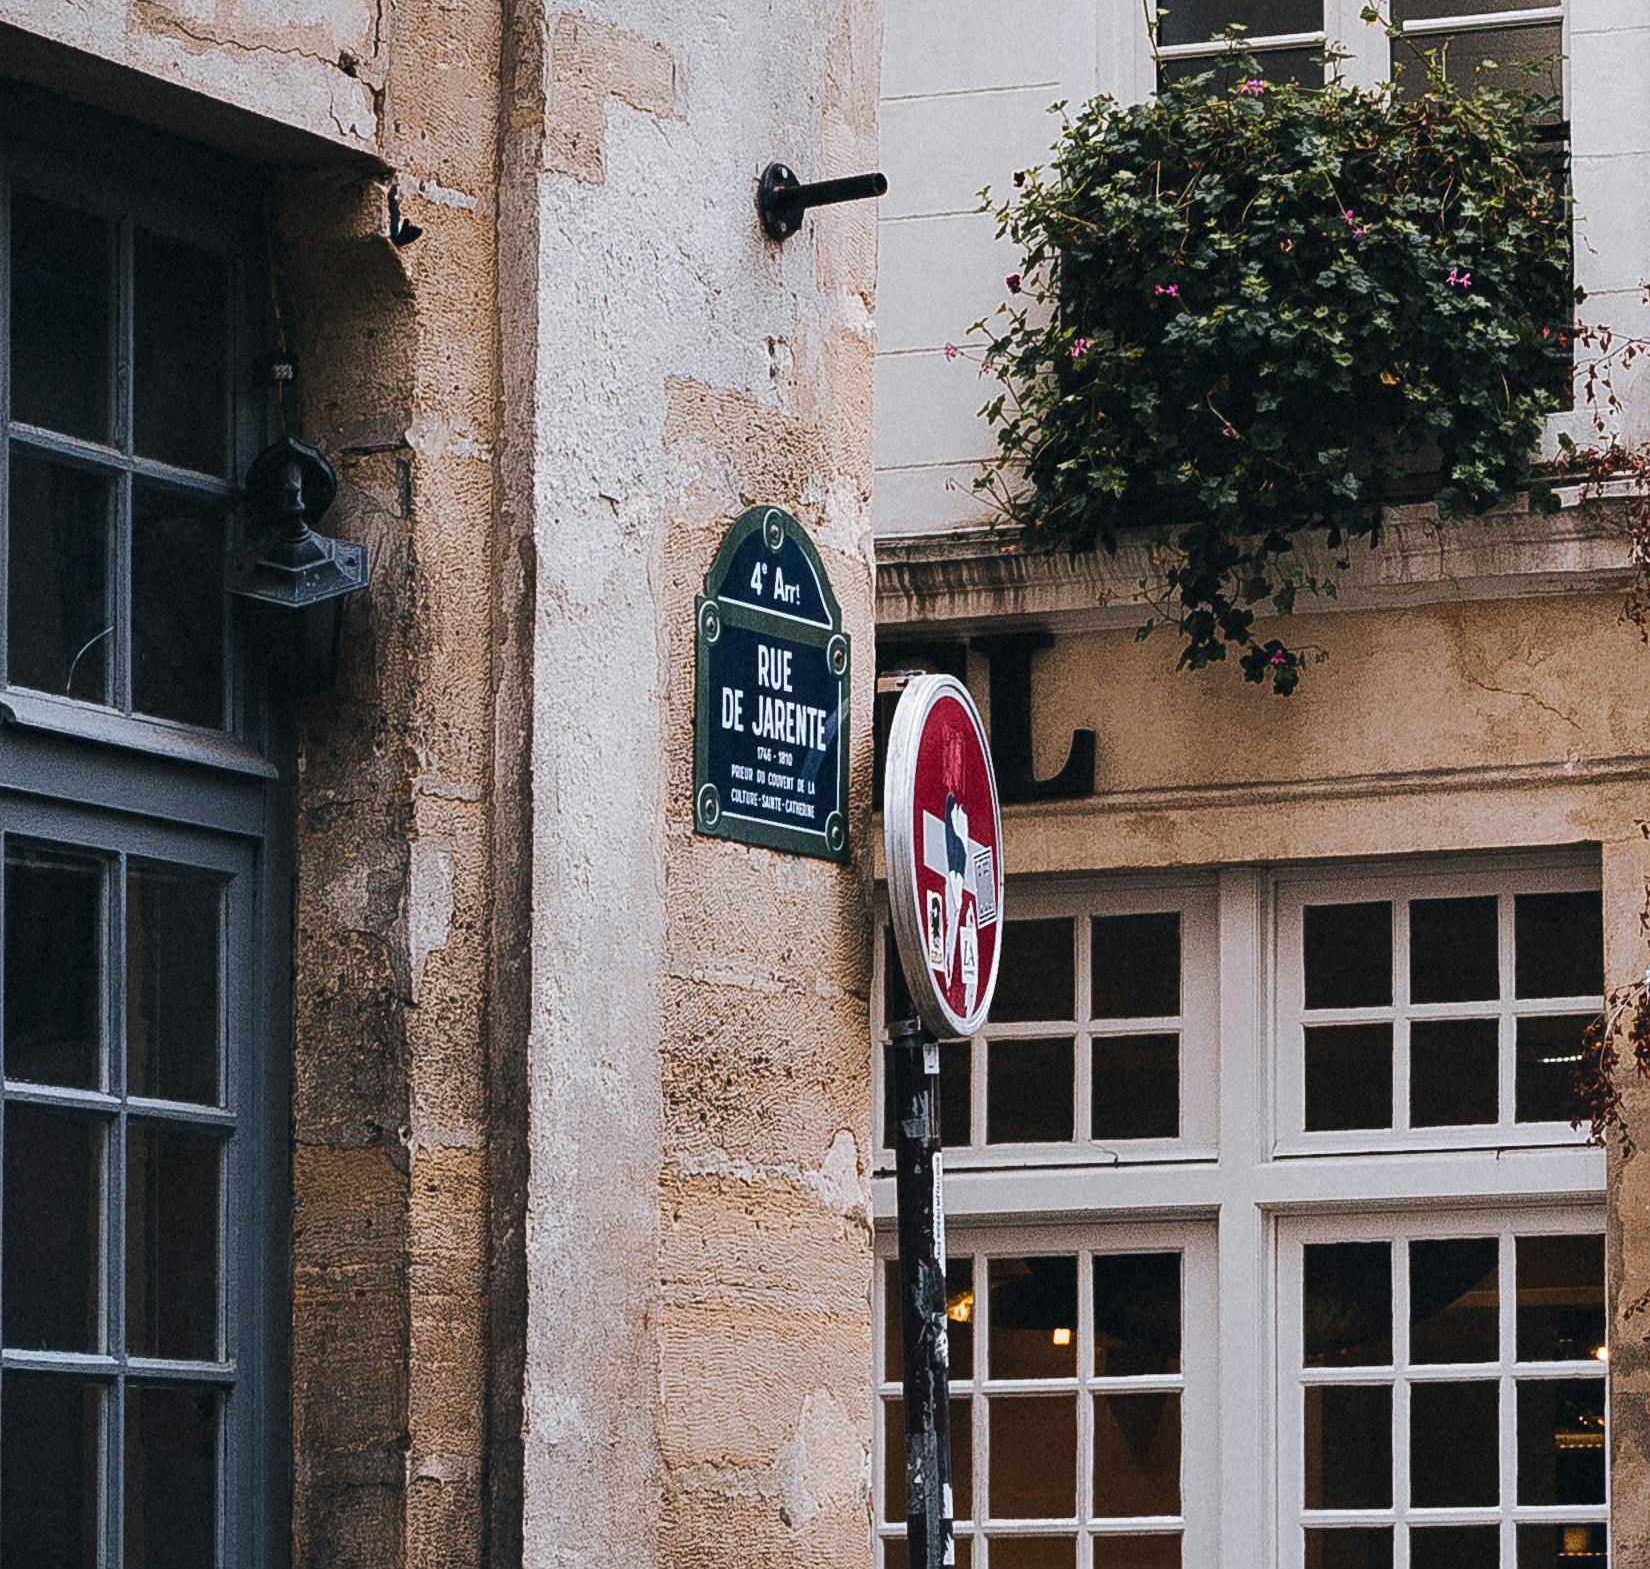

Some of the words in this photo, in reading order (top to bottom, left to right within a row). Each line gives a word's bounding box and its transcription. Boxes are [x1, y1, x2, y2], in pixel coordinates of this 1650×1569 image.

[758, 644, 793, 693] RUE
[721, 686, 744, 733] DE
[752, 695, 827, 751] JARENTE
[731, 764, 754, 782] PRIEUR
[756, 769, 766, 785] DU
[767, 772, 795, 791] COUVENT
[796, 778, 805, 793] DE
[807, 780, 816, 795] LA
